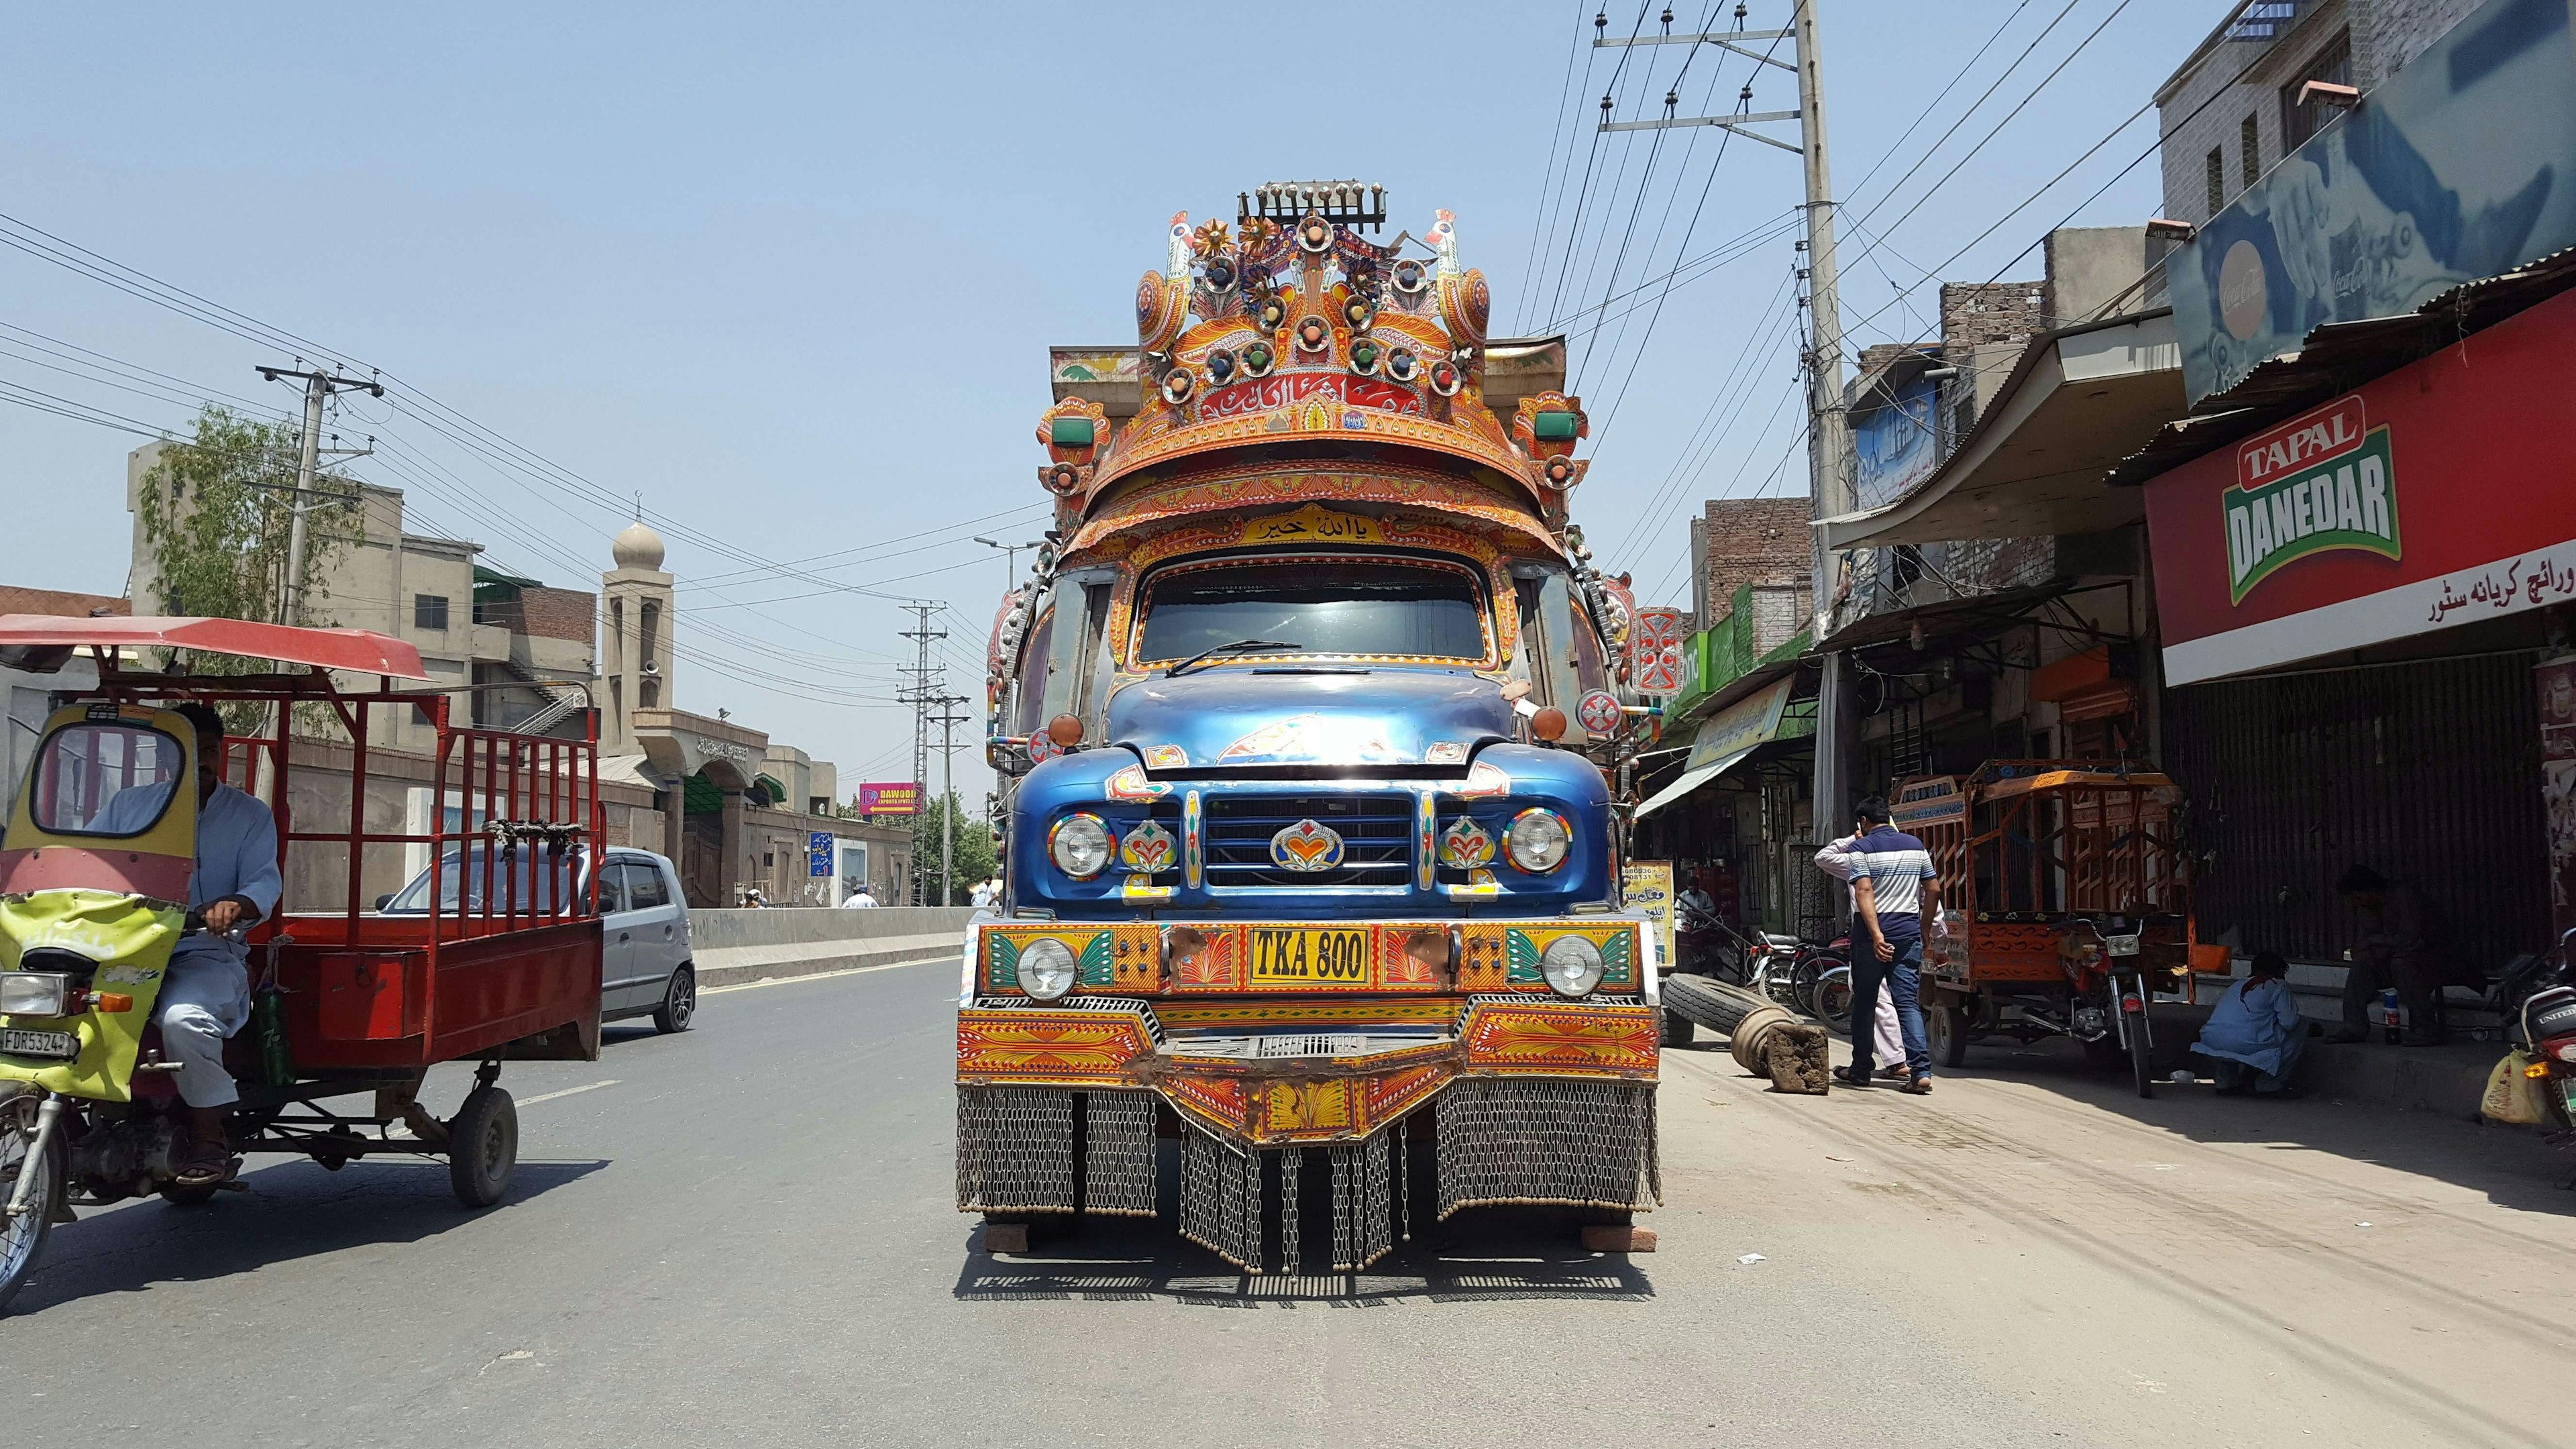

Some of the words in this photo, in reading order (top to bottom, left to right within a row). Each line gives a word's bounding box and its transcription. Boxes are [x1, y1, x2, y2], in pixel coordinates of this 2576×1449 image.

[2245, 413, 2358, 480] TAPAL
[1253, 517, 1307, 539] خیر
[2229, 454, 2392, 586] DANEDAR
[2428, 580, 2468, 623] سٹور
[2471, 558, 2522, 607] کریانہ
[1258, 931, 1308, 976] TKA
[1317, 932, 1362, 979] 800
[2539, 1009, 2575, 1024] UNITED
[5, 1031, 58, 1052] FDR5324
